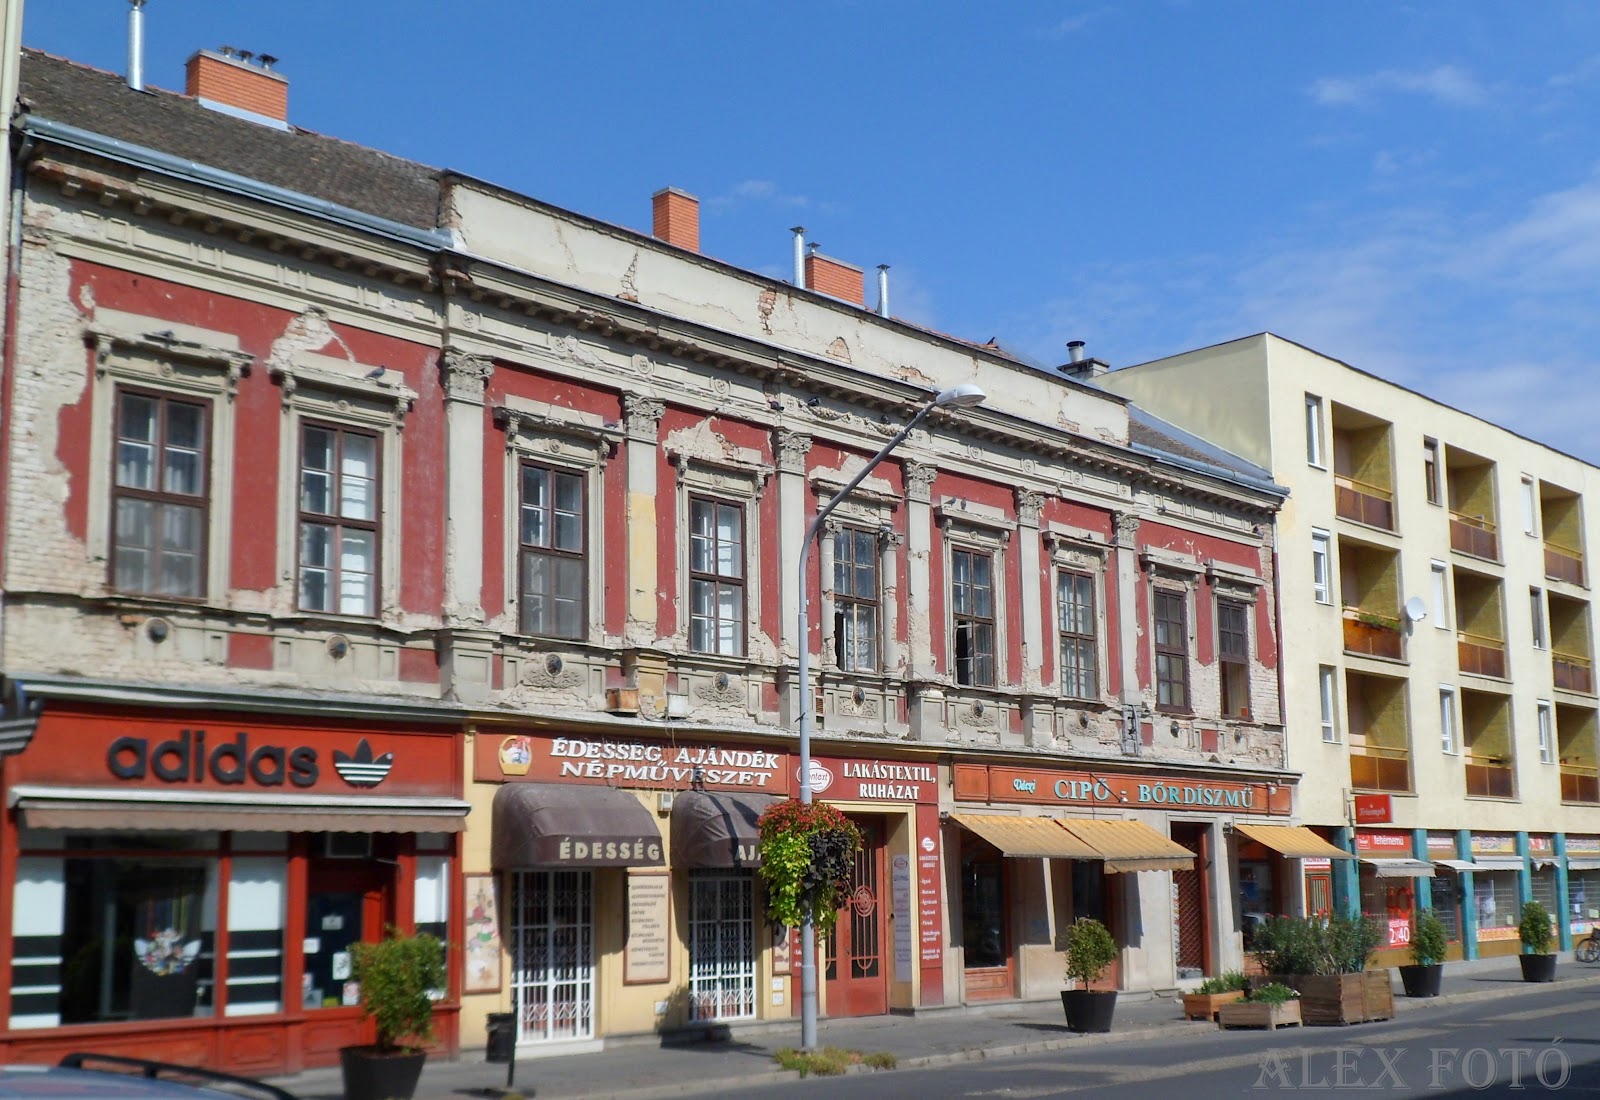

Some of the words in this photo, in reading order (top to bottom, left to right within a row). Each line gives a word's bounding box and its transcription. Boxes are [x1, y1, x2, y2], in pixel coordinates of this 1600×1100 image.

[107, 730, 319, 787] adidas
[675, 748, 779, 769] AJÁNDÉK
[560, 760, 772, 787] NÉPMŰVÉSZET
[843, 760, 936, 783] LAKÁSTEXTIL,
[860, 781, 919, 800] RUHÁZAT
[1054, 778, 1110, 800] CIPŐ
[1359, 808, 1386, 816] Triumph
[560, 837, 660, 860] ÉDESSÉG
